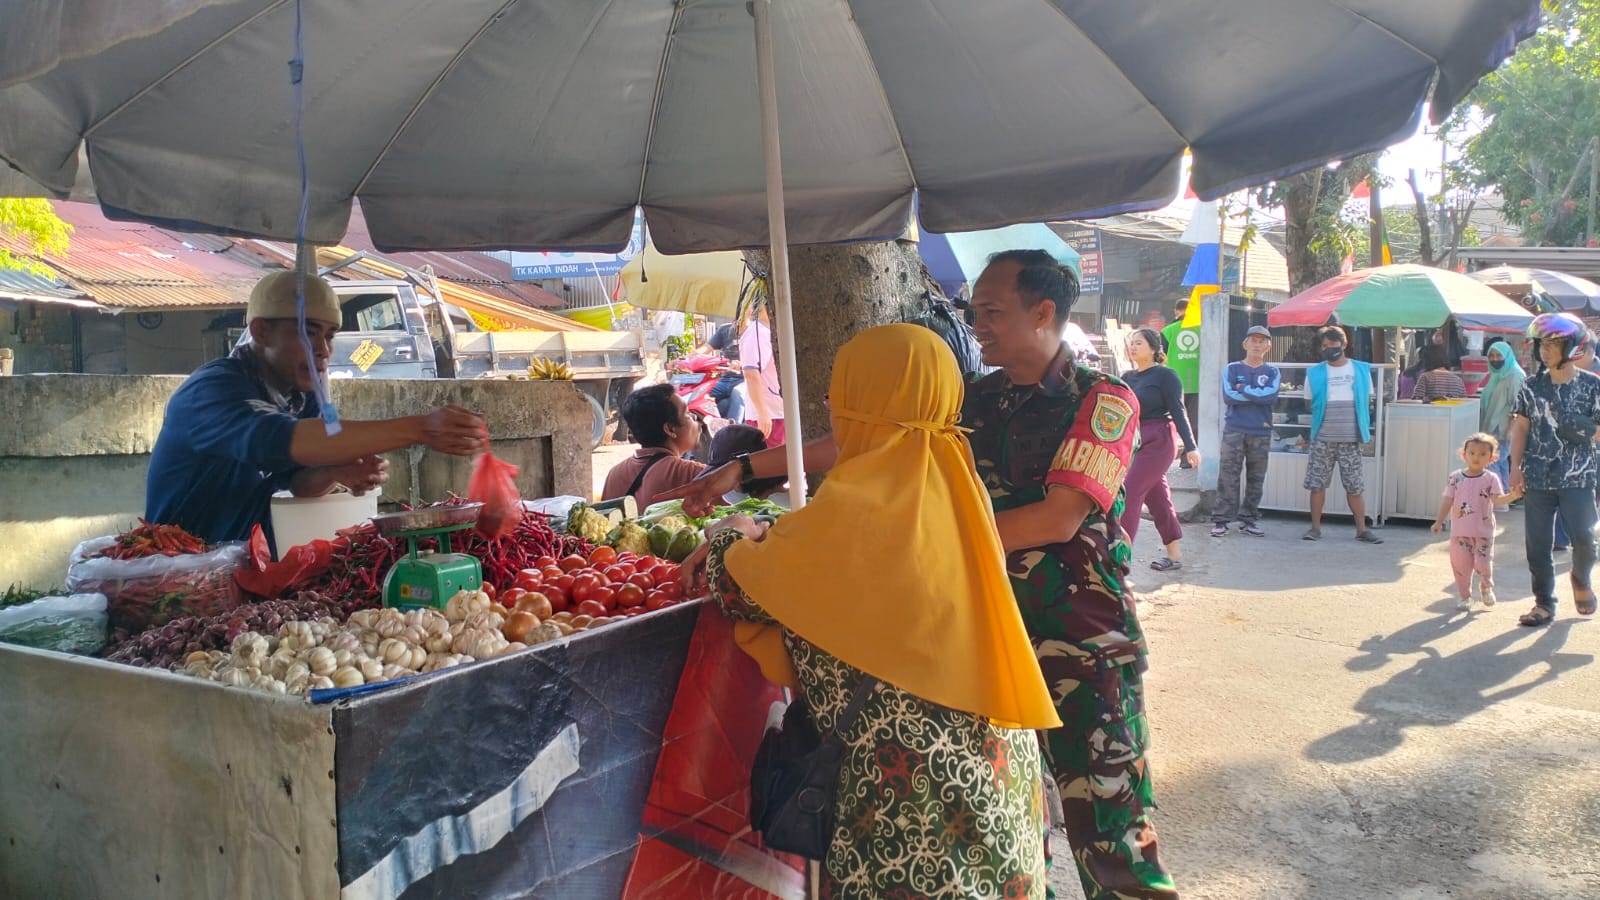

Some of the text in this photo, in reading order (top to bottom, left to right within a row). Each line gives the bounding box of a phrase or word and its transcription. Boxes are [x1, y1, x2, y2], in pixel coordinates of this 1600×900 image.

[516, 268, 526, 276] TK
[528, 265, 552, 275] KARYA
[555, 264, 579, 273] INDAH
